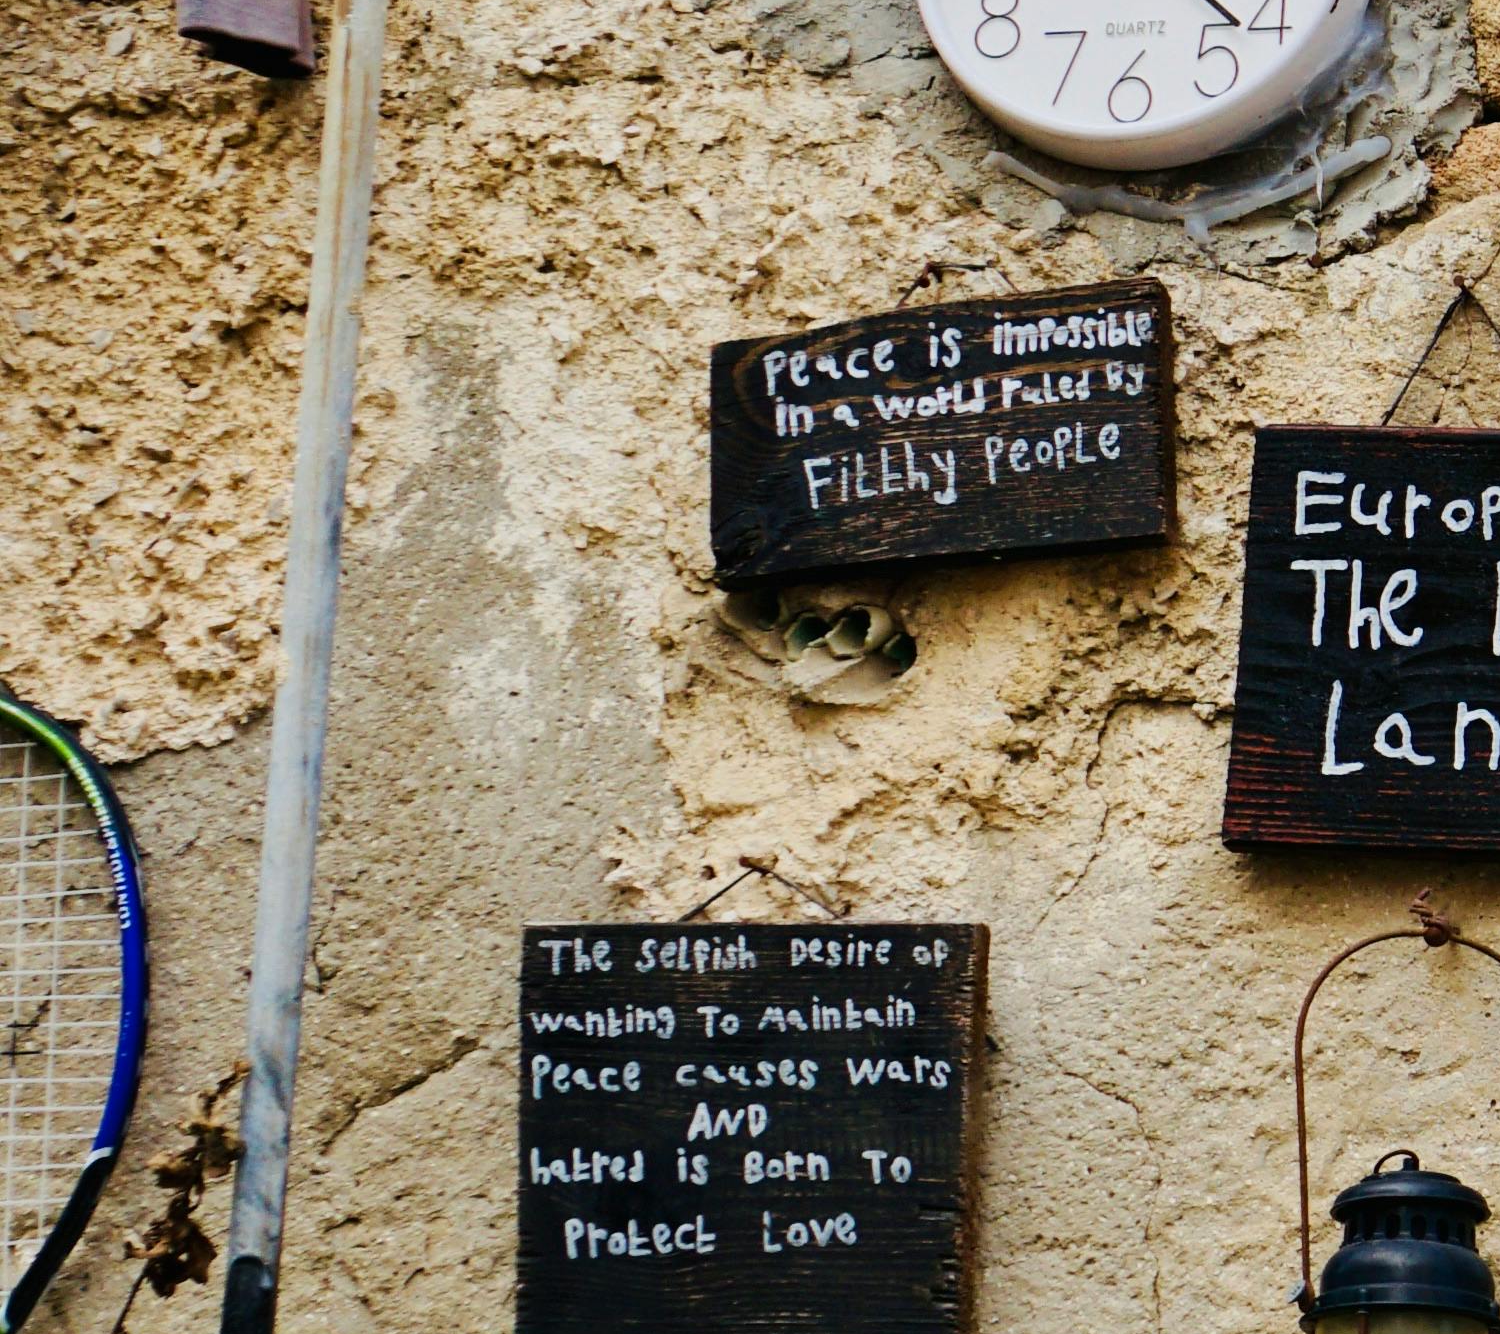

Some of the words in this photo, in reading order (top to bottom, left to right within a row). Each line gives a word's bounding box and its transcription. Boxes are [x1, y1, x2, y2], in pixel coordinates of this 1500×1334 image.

[1106, 20, 1166, 36] QUARTZ
[930, 322, 962, 367] is
[775, 397, 813, 436] in
[833, 404, 859, 427] a
[1291, 559, 1423, 650] The
[539, 936, 612, 975] The
[913, 940, 949, 966] of
[688, 1103, 767, 1140] AND
[678, 1149, 708, 1184] is
[744, 1152, 829, 1184] Born
